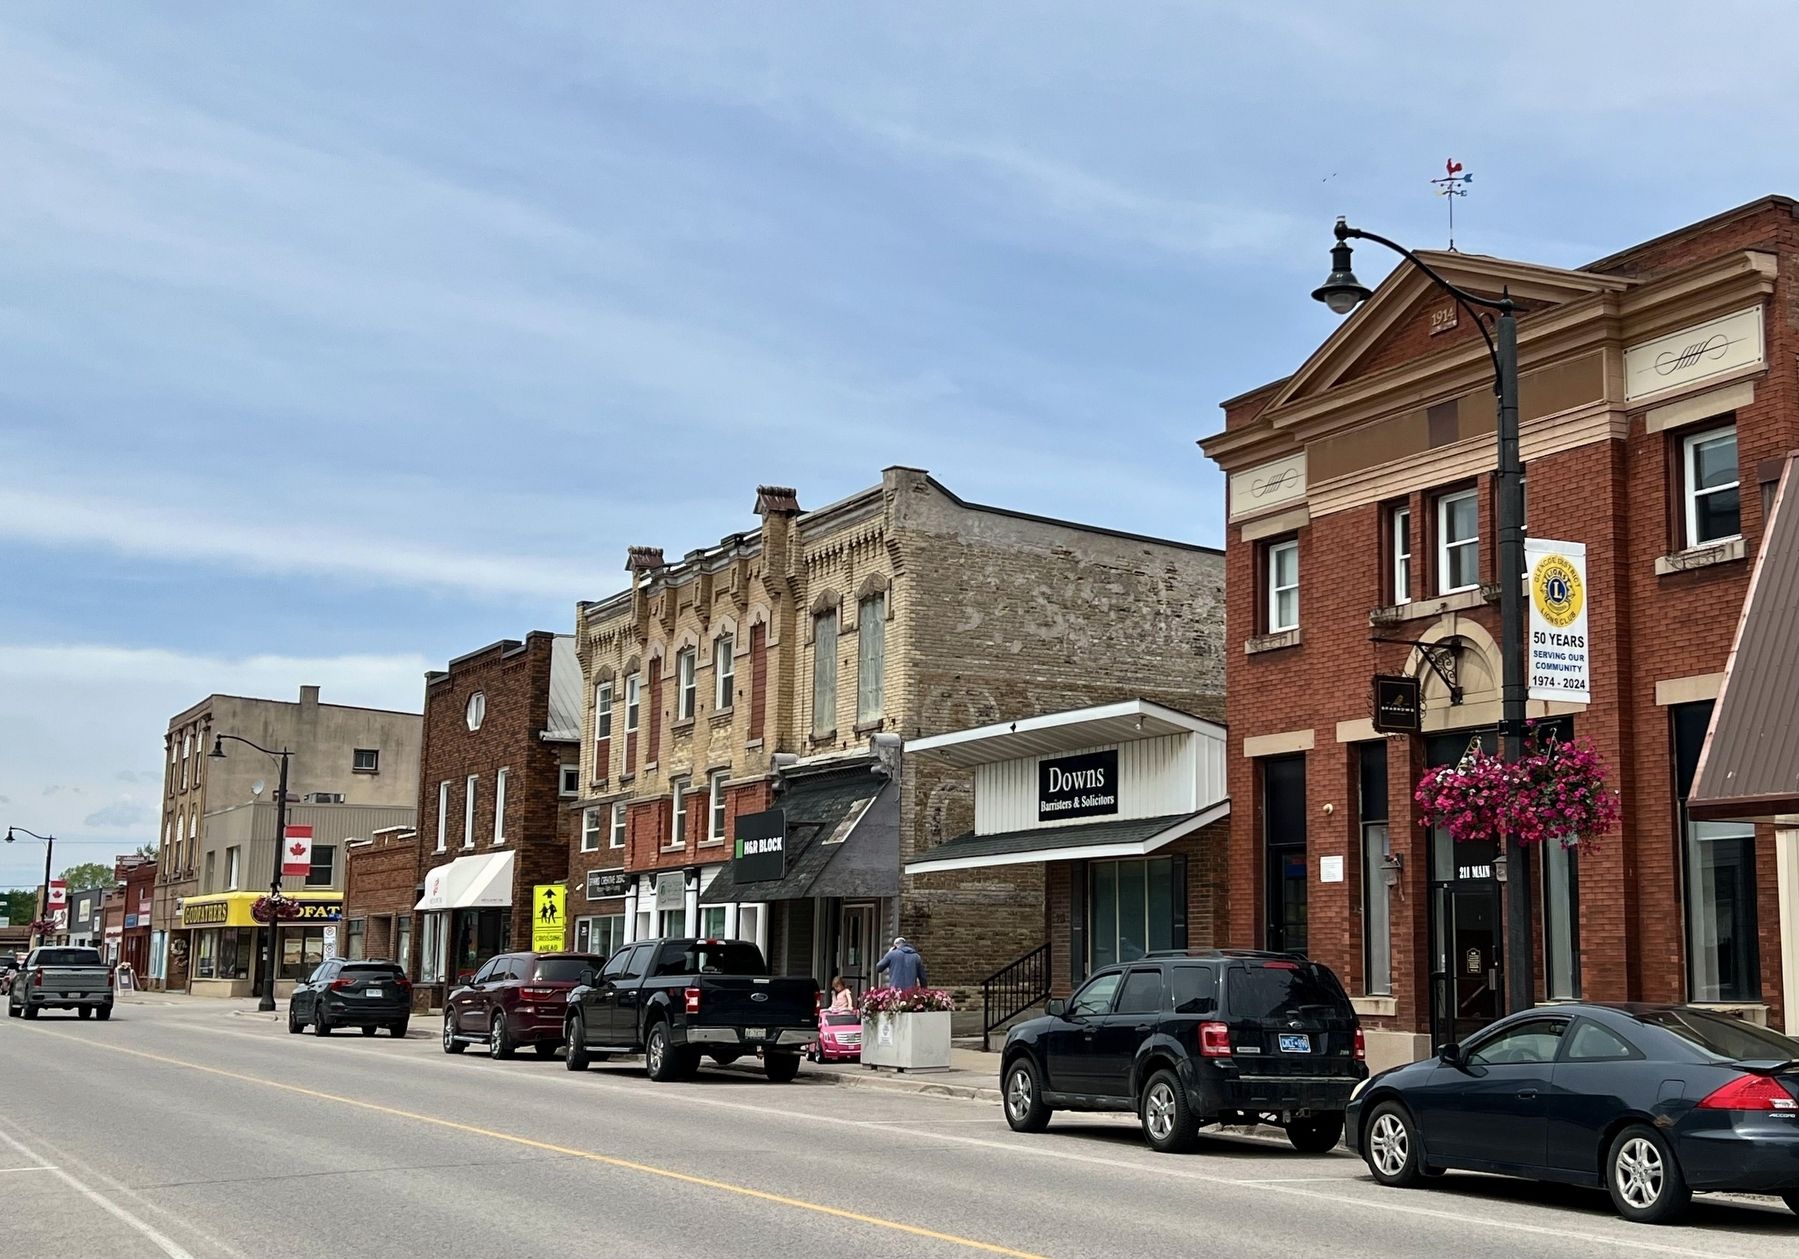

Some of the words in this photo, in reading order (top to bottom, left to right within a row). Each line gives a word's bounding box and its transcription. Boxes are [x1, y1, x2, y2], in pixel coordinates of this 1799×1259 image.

[1431, 306, 1454, 327] 1914
[1546, 568, 1567, 580] LIONS
[1553, 581, 1563, 599] L
[1540, 607, 1559, 626] LIONS
[1559, 611, 1577, 626] CLUB
[1533, 631, 1546, 645] 50
[1549, 632, 1585, 648] YEARS
[1533, 650, 1567, 661] SERVING
[1568, 653, 1585, 662] OUR
[1535, 661, 1583, 673] COMMUNITY
[1532, 675, 1555, 687] 1974
[1563, 677, 1586, 690] 2024
[1048, 767, 1105, 793] Downs
[1041, 799, 1072, 812] Barristers
[1073, 796, 1080, 809] &
[1081, 794, 1115, 808] Solicitors
[744, 840, 758, 855] H&R
[758, 837, 783, 853] BLOCK
[1459, 866, 1470, 879] 211
[1471, 865, 1491, 878] MAIN
[185, 903, 227, 924] GODFATHERS
